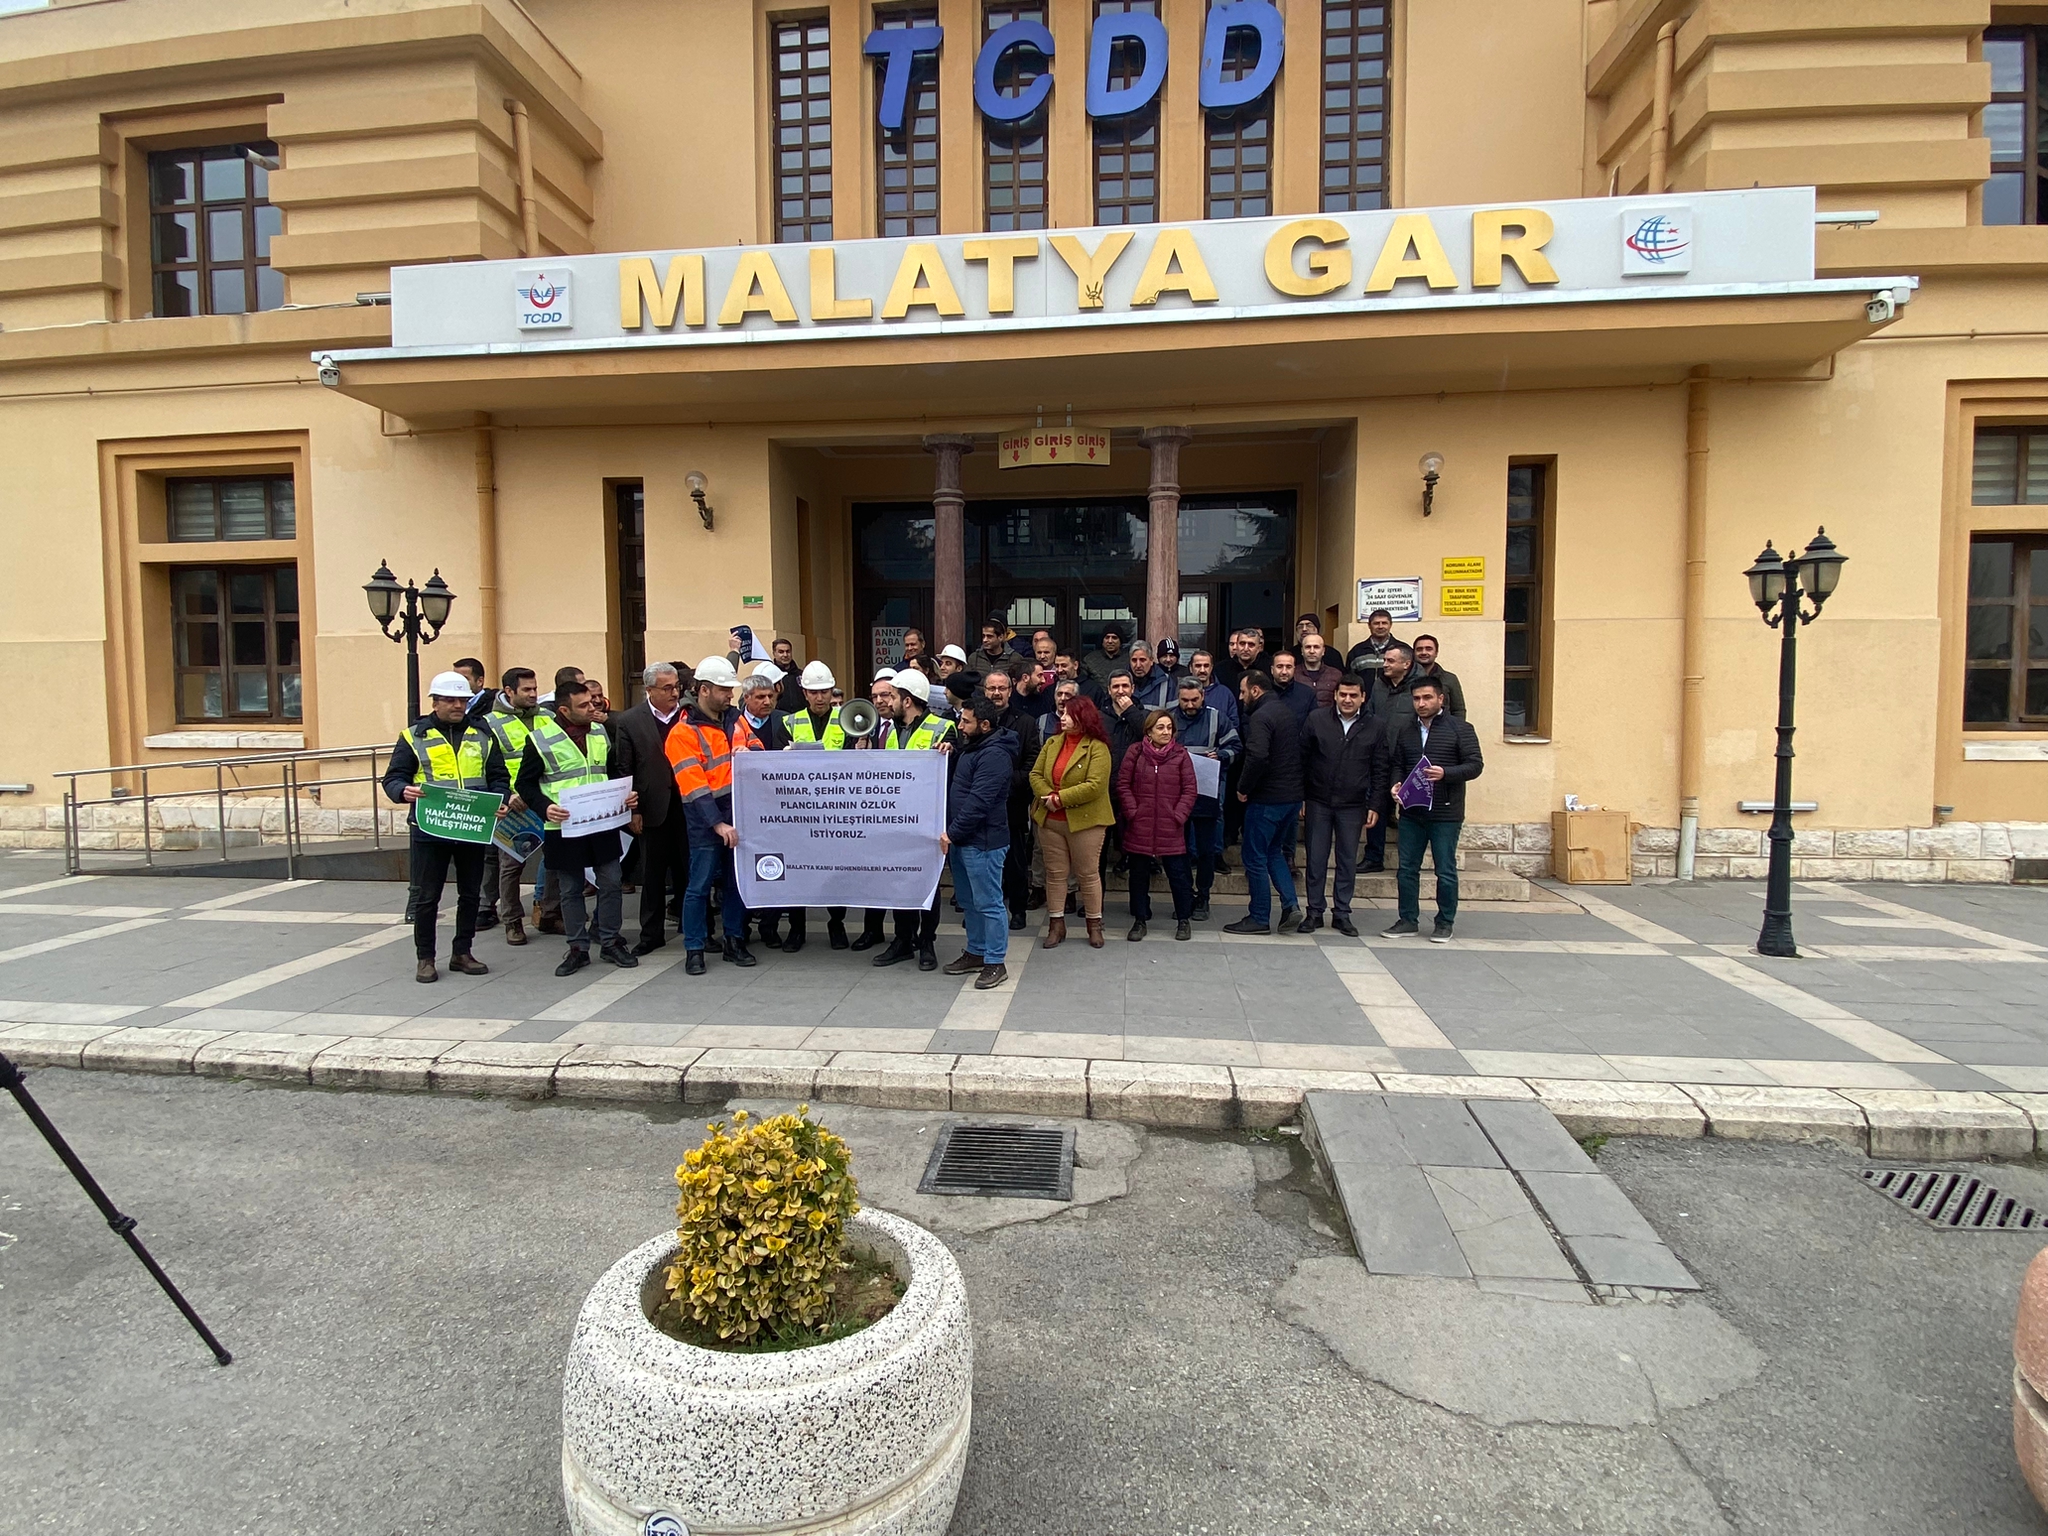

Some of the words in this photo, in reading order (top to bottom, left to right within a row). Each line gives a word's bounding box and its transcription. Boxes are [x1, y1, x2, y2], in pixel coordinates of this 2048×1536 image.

[864, 0, 1285, 129] TCDD
[618, 228, 1220, 330] MALATYA
[1264, 207, 1561, 300] GAR
[523, 312, 562, 324] TCDD
[1002, 436, 1030, 450] GİRİŞ
[1034, 433, 1073, 447] GİRİŞ
[1077, 433, 1106, 449] GİRİŞ
[875, 628, 902, 637] ANNE
[875, 637, 900, 647] BABA
[761, 772, 805, 781] KAMUDA
[808, 771, 853, 783] ÇALIŞAN
[855, 771, 916, 781] MÜHENDİS,
[775, 786, 812, 796] MİMAR,
[814, 786, 846, 797] ŞEHİR
[848, 787, 862, 795] VE
[865, 785, 901, 795] BÖLGE
[445, 802, 470, 812] MALİ
[780, 801, 857, 810] PLANCILARININ
[860, 799, 896, 810] ÖZLÜK
[425, 807, 487, 824] HAKLARINDA
[760, 815, 820, 824] HAKLARININ
[823, 813, 919, 825] İYİLEŞTİRİLMESİNİ
[426, 815, 483, 833] İYİLEŞTİRME
[810, 828, 867, 839] İSTİYORUZ.
